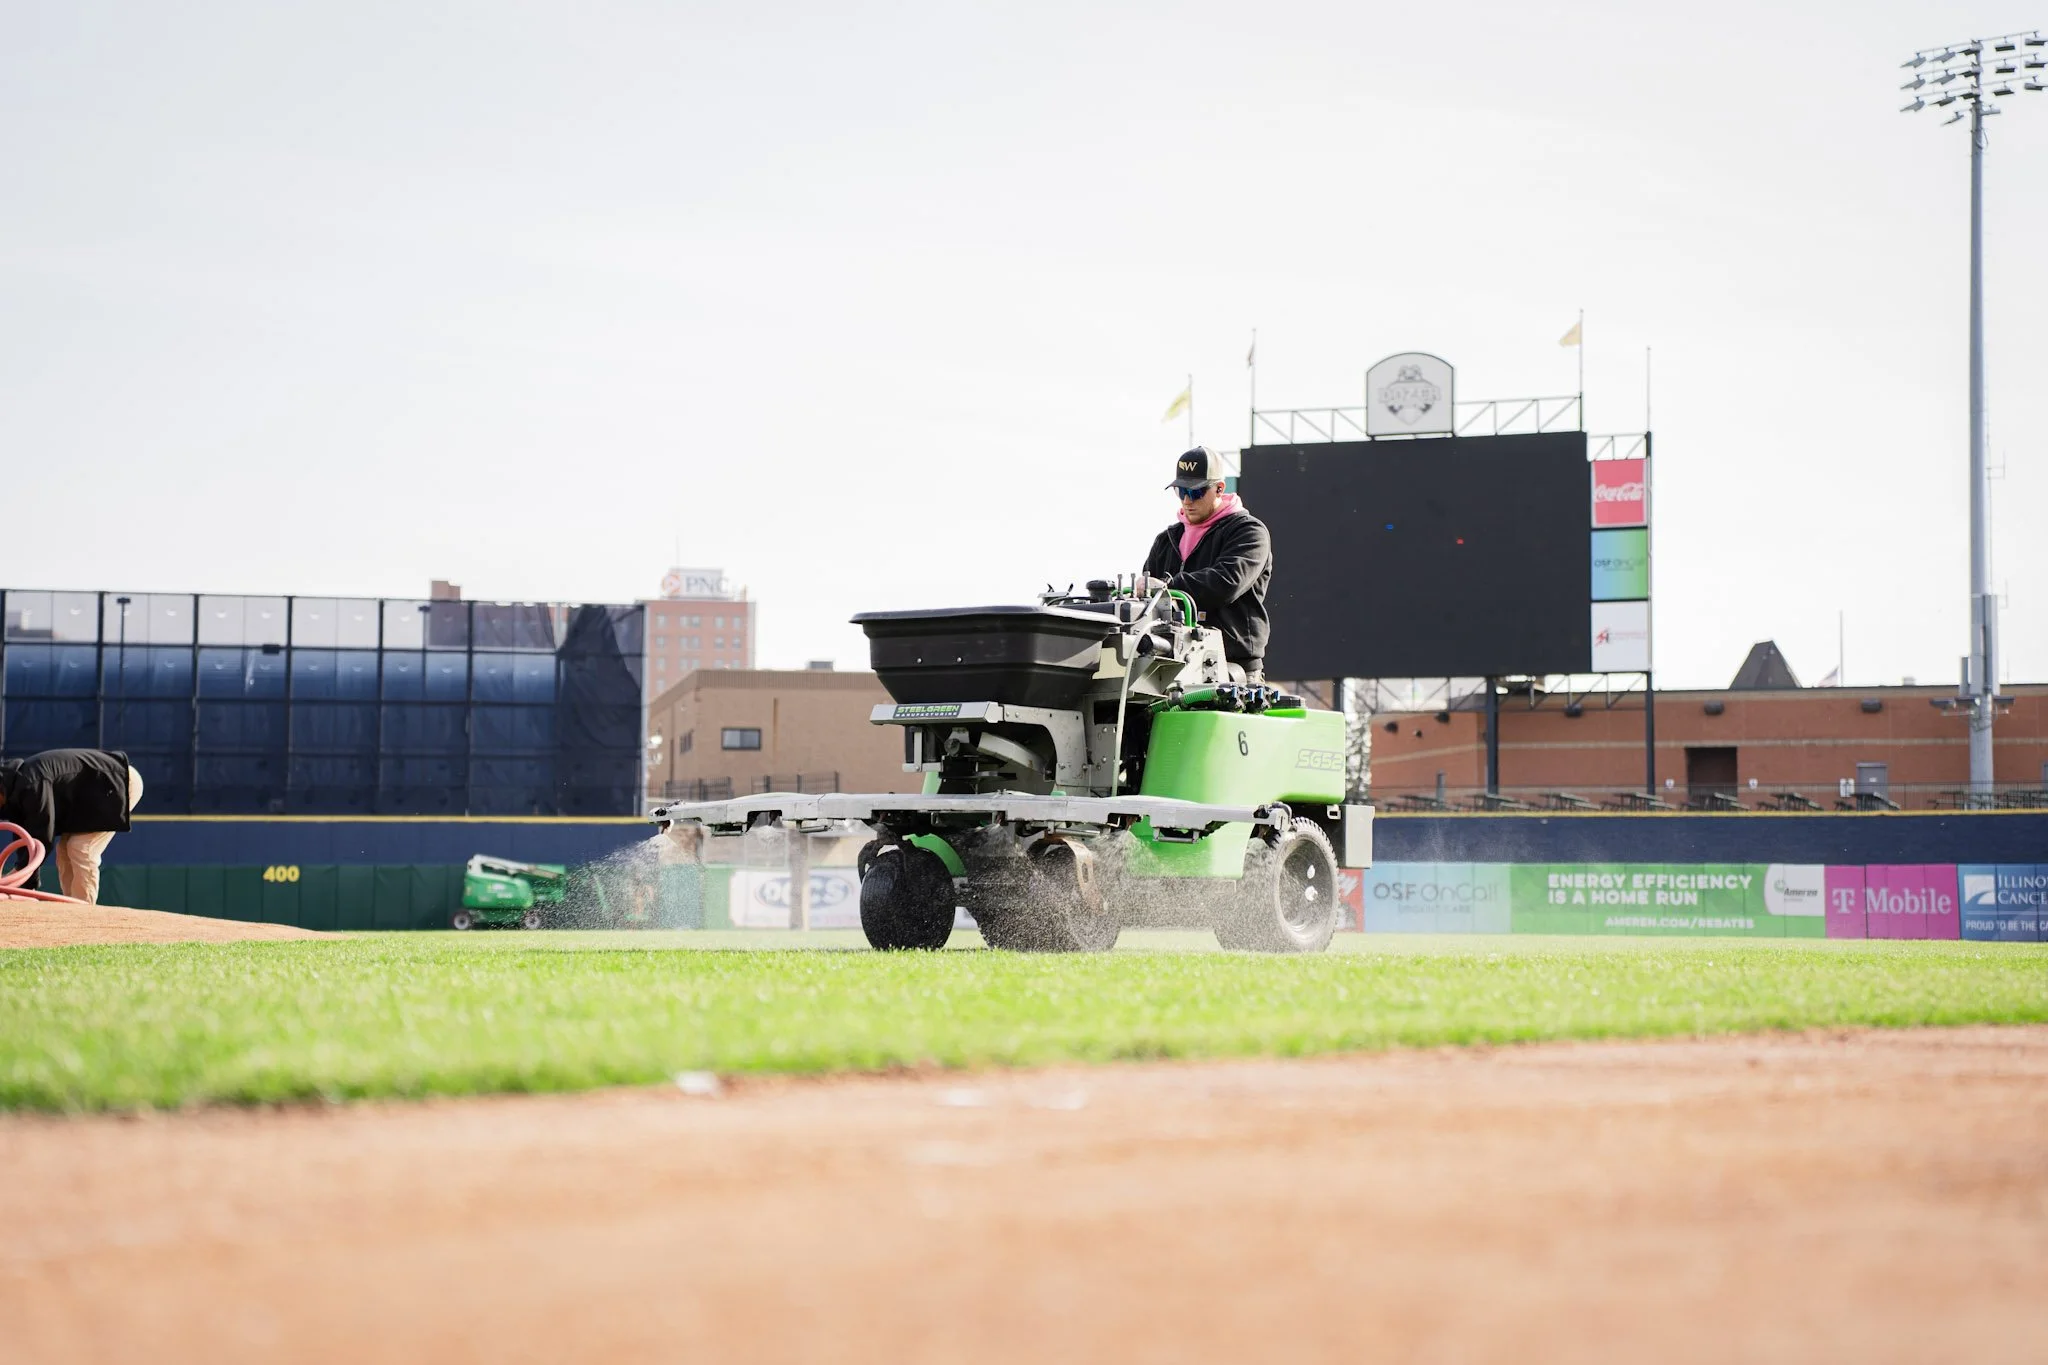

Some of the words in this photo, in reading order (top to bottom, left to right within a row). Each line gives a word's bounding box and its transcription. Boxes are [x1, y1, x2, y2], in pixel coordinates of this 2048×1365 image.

[685, 575, 730, 593] PNC
[897, 705, 960, 713] STEELGREEN
[1238, 731, 1248, 756] 6
[1295, 749, 1345, 771] SG52
[263, 865, 300, 882] 400
[1548, 873, 1627, 889] ENERGY
[1632, 874, 1753, 890] EFFICIENCY
[1998, 874, 2048, 889] ILLINO
[1373, 882, 1416, 900] OSF
[1421, 882, 1500, 902] OnCall
[1548, 889, 1567, 905] IS
[1572, 890, 1586, 905] A
[1591, 890, 1649, 905] HOME
[1656, 891, 1698, 906] RUN
[1784, 887, 1818, 896] Ameren
[1865, 887, 1952, 914] Mobile
[1605, 916, 1754, 929] AMEREN.COM/REBATES
[1966, 920, 1994, 931] PROUD
[2008, 920, 2019, 931] BE
[2020, 920, 2036, 931] THE
